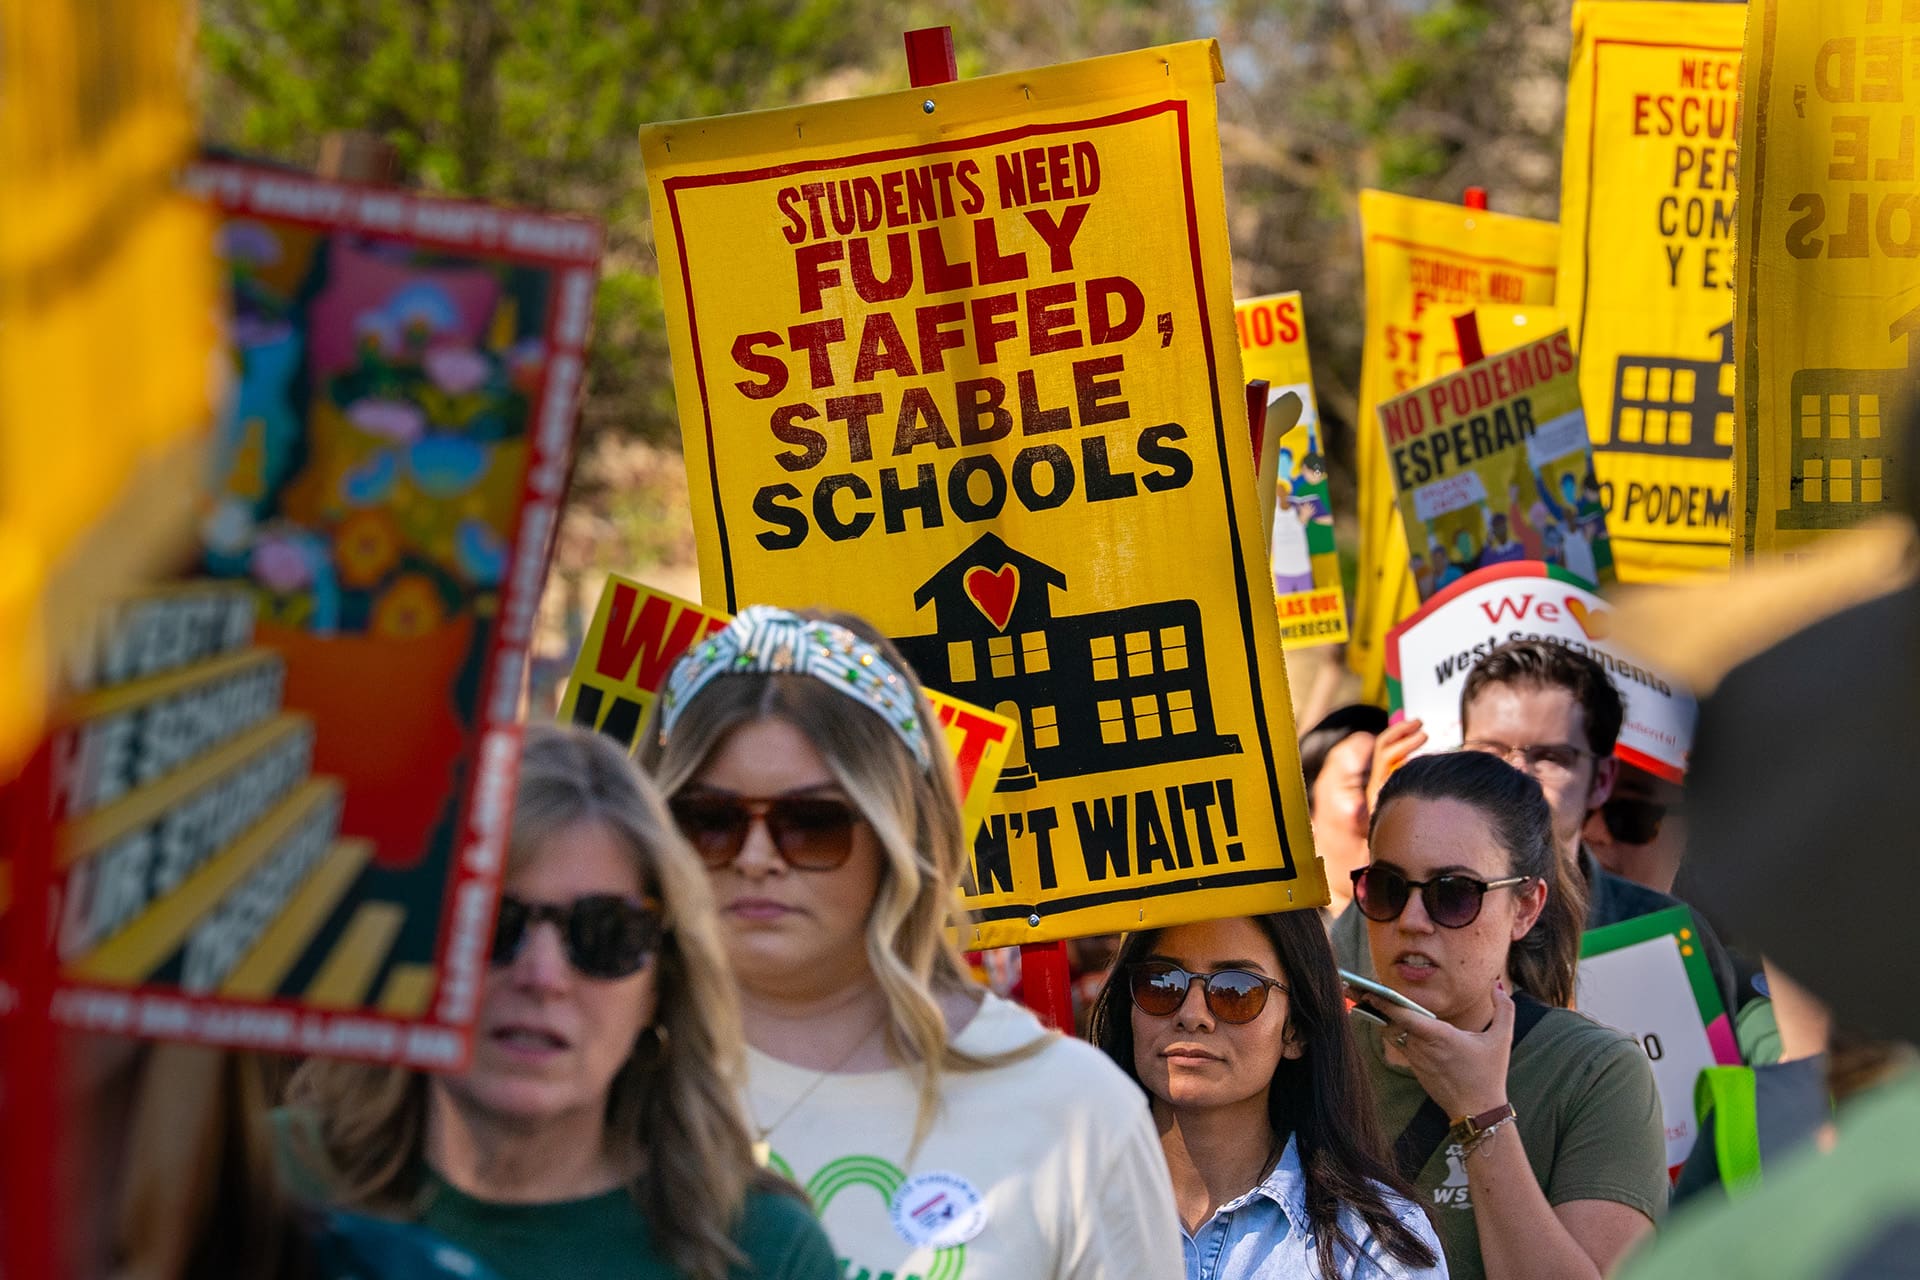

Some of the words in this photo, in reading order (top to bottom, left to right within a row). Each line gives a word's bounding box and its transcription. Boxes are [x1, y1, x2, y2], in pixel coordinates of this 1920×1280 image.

[777, 158, 985, 245] STUDENTS
[995, 140, 1101, 210] NEED
[1660, 196, 1737, 239] COM
[1674, 145, 1737, 191] PER
[795, 203, 1091, 314] FULLY
[1666, 245, 1684, 288] Y
[730, 275, 1175, 400] STAFFED,
[769, 354, 1131, 473] STABLE
[1383, 396, 1425, 445] NO
[1428, 334, 1574, 426] PODEMOS
[752, 422, 1194, 552] SCHOOLS
[1392, 397, 1537, 491] ESPERAR
[1624, 483, 1730, 528] PODEM
[1480, 593, 1561, 625] We
[1435, 635, 1497, 685] West
[959, 806, 1060, 897] N'T
[1071, 777, 1246, 882] WAIT!
